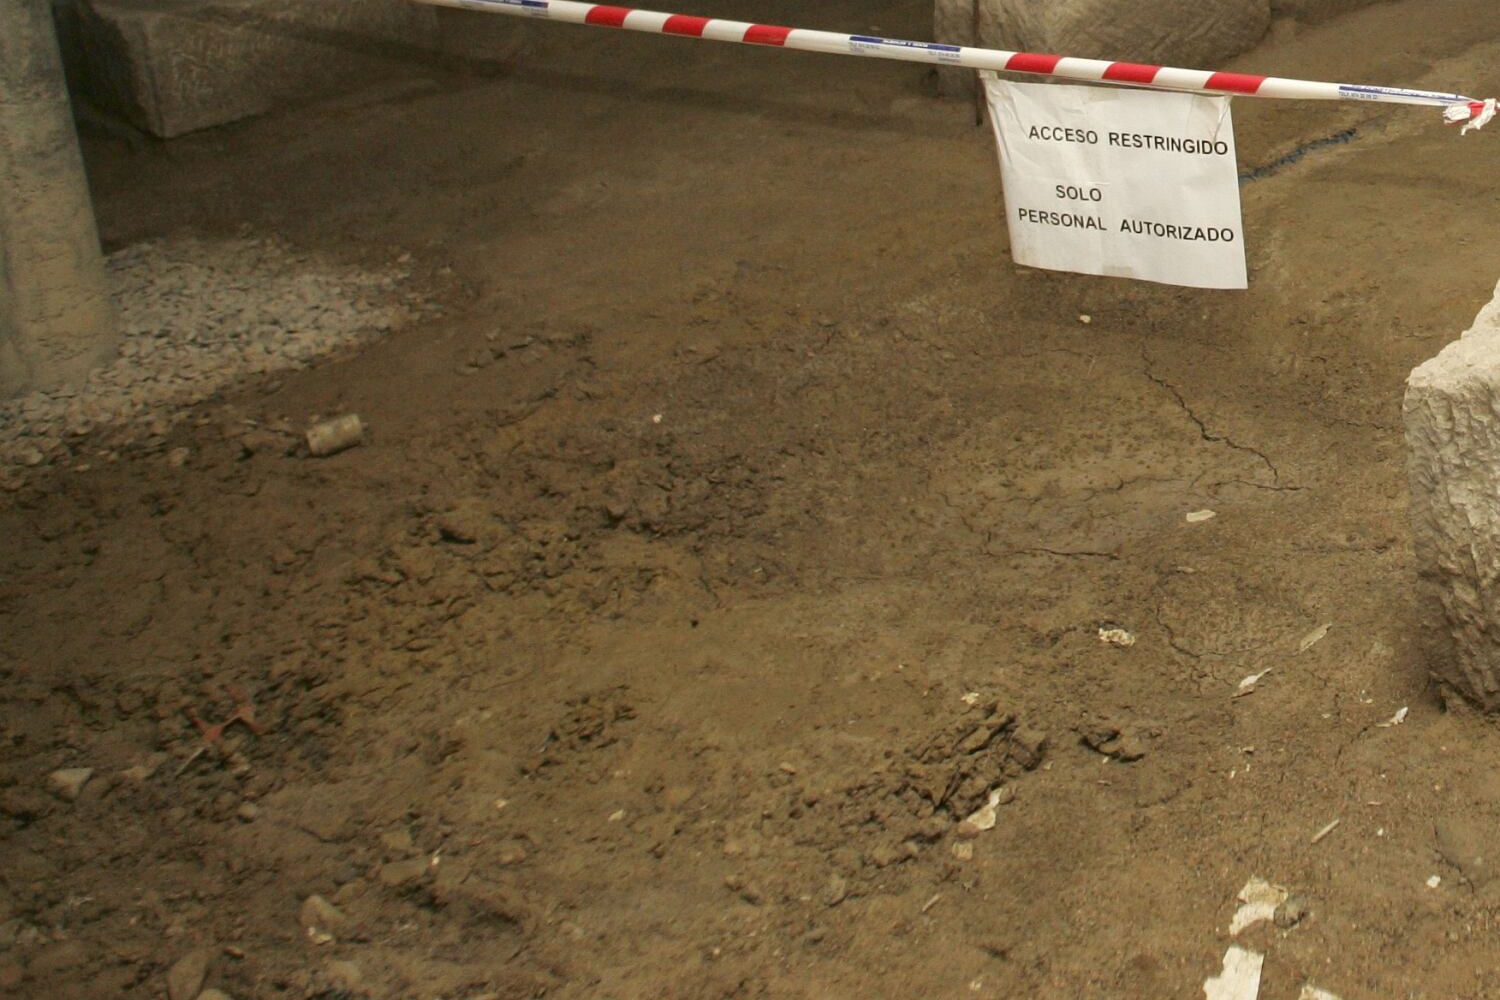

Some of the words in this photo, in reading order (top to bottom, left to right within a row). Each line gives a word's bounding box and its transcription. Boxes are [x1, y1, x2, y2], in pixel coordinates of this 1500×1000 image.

[1028, 125, 1098, 144] ACCESO
[1109, 132, 1228, 155] RESTRINGIDO
[1055, 185, 1102, 202] SOLO
[1018, 208, 1107, 231] PERSONAL
[1120, 219, 1235, 242] AUTORIZADO
